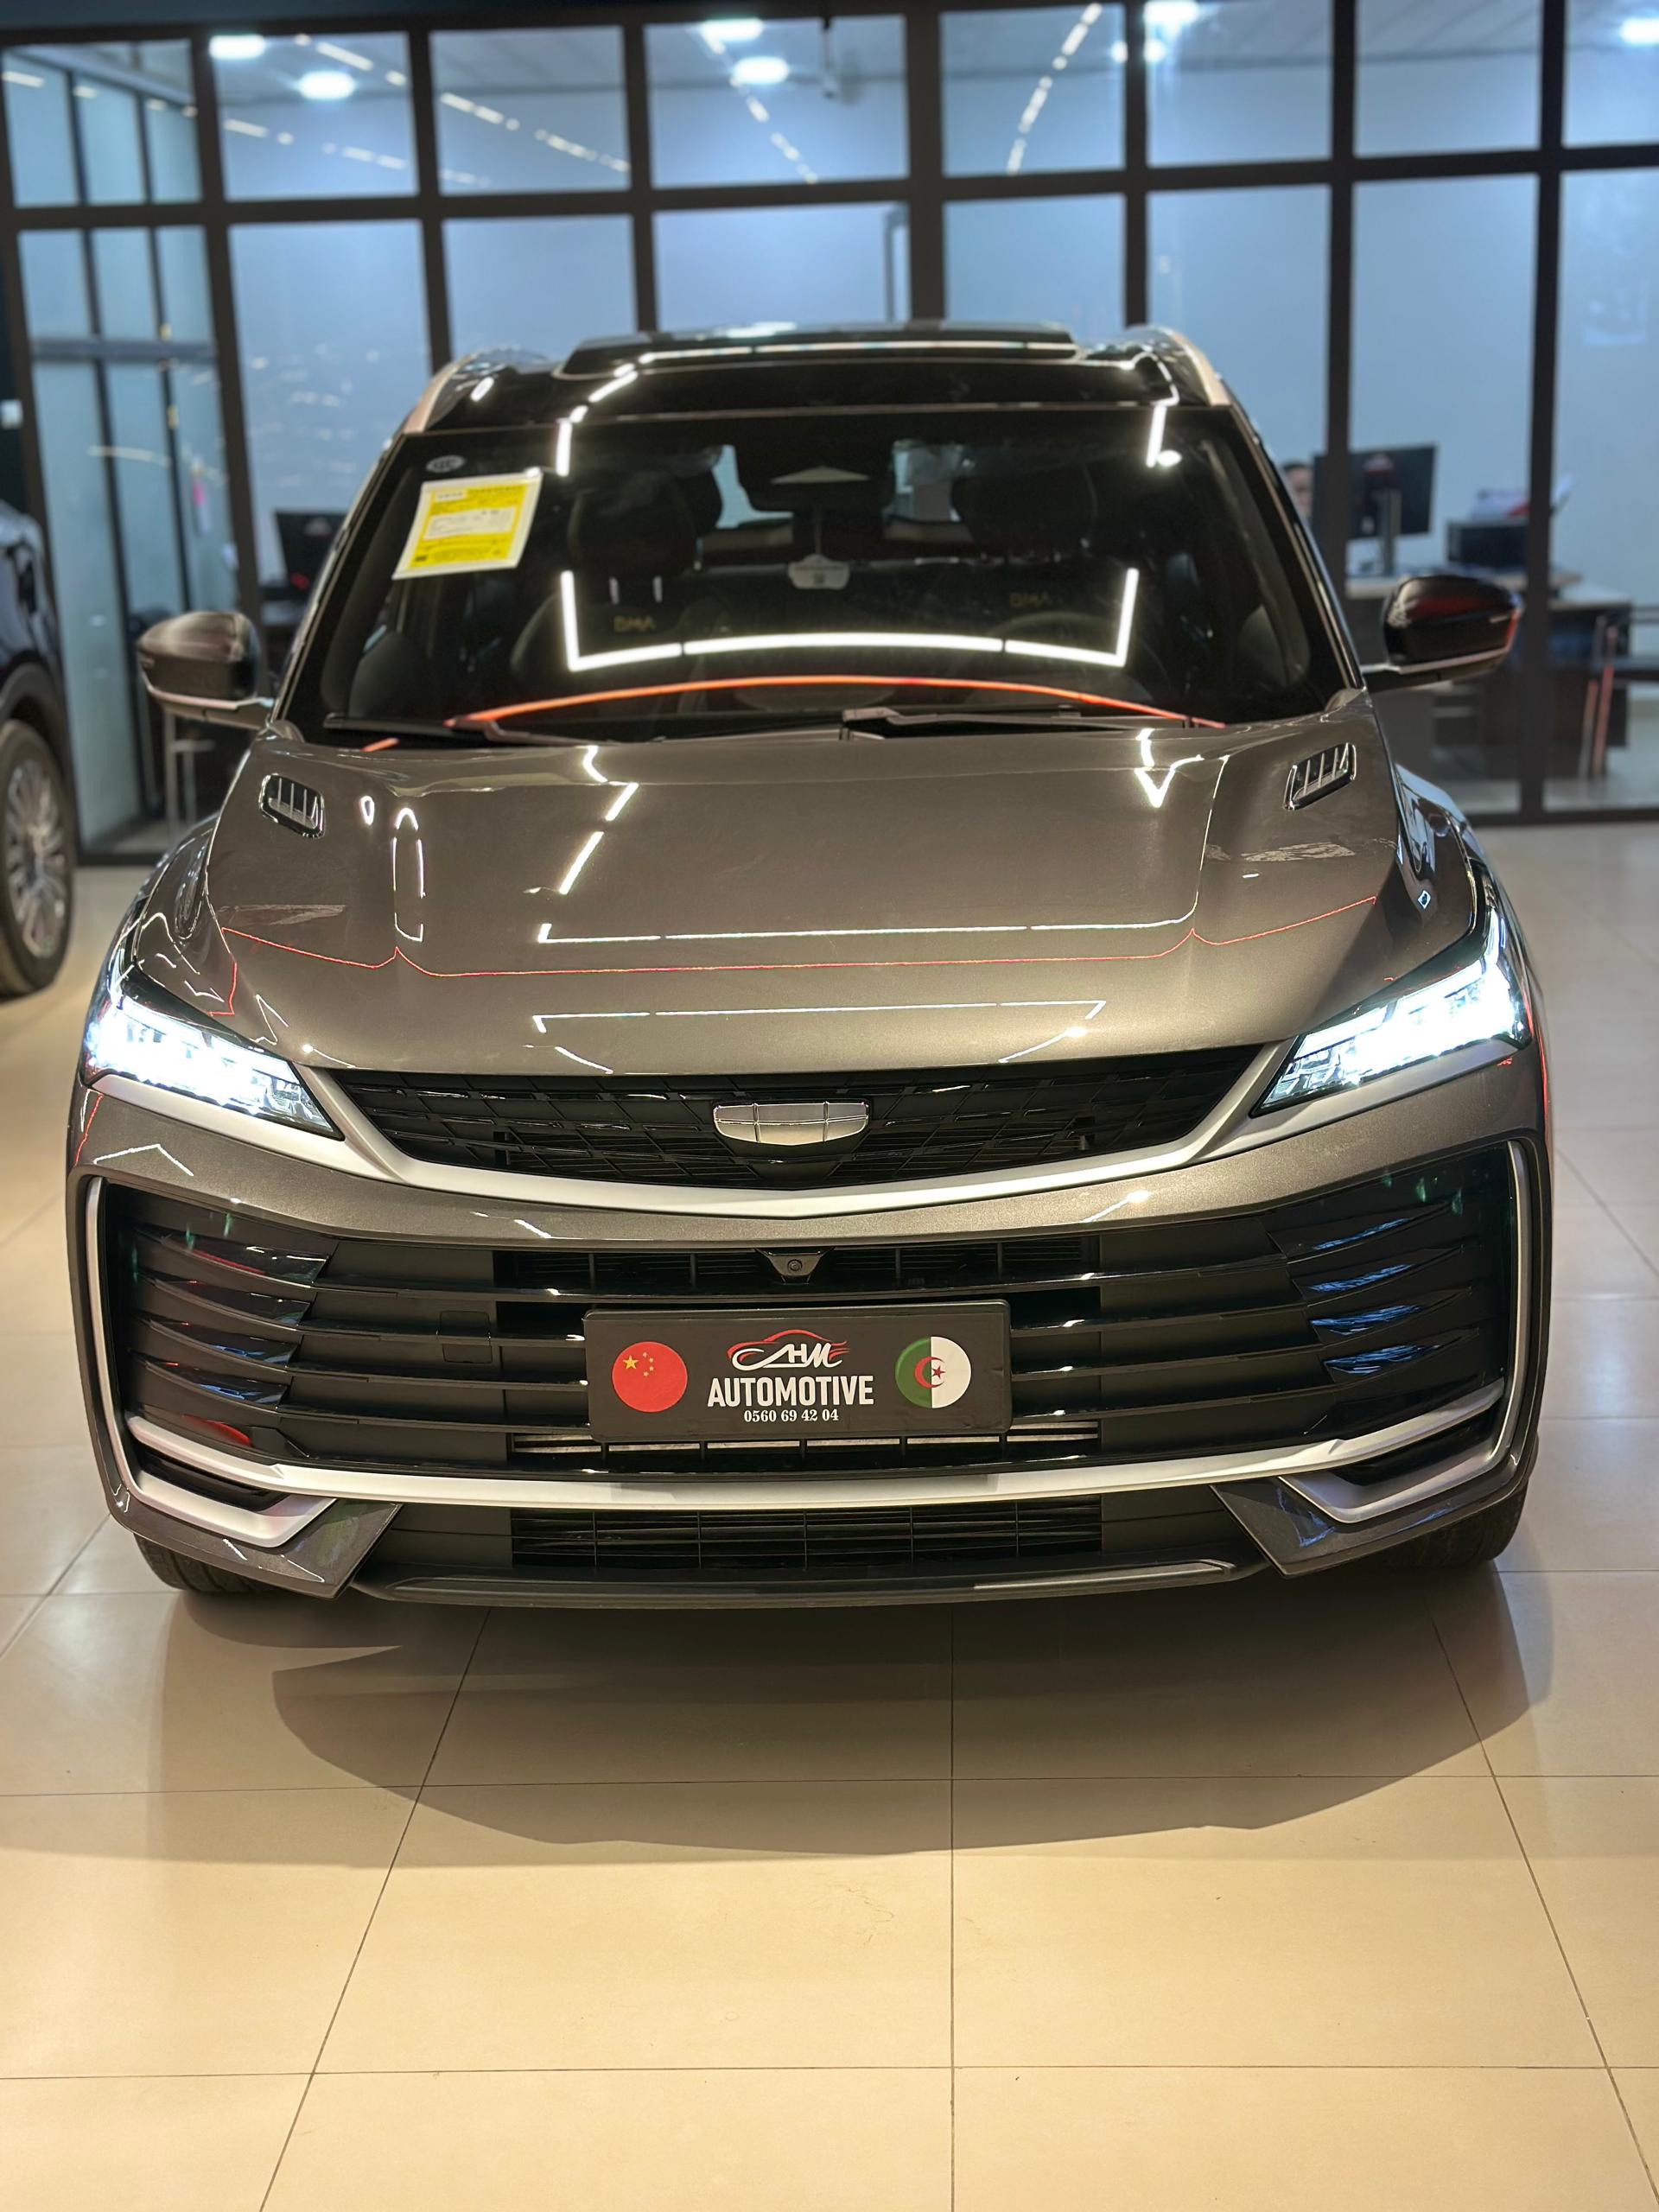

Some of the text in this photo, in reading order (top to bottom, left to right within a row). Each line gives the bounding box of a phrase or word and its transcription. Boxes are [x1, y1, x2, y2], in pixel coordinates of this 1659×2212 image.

[707, 1376, 874, 1408] AUTOMOTIVE
[743, 1408, 839, 1422] 0560 69 42 04
